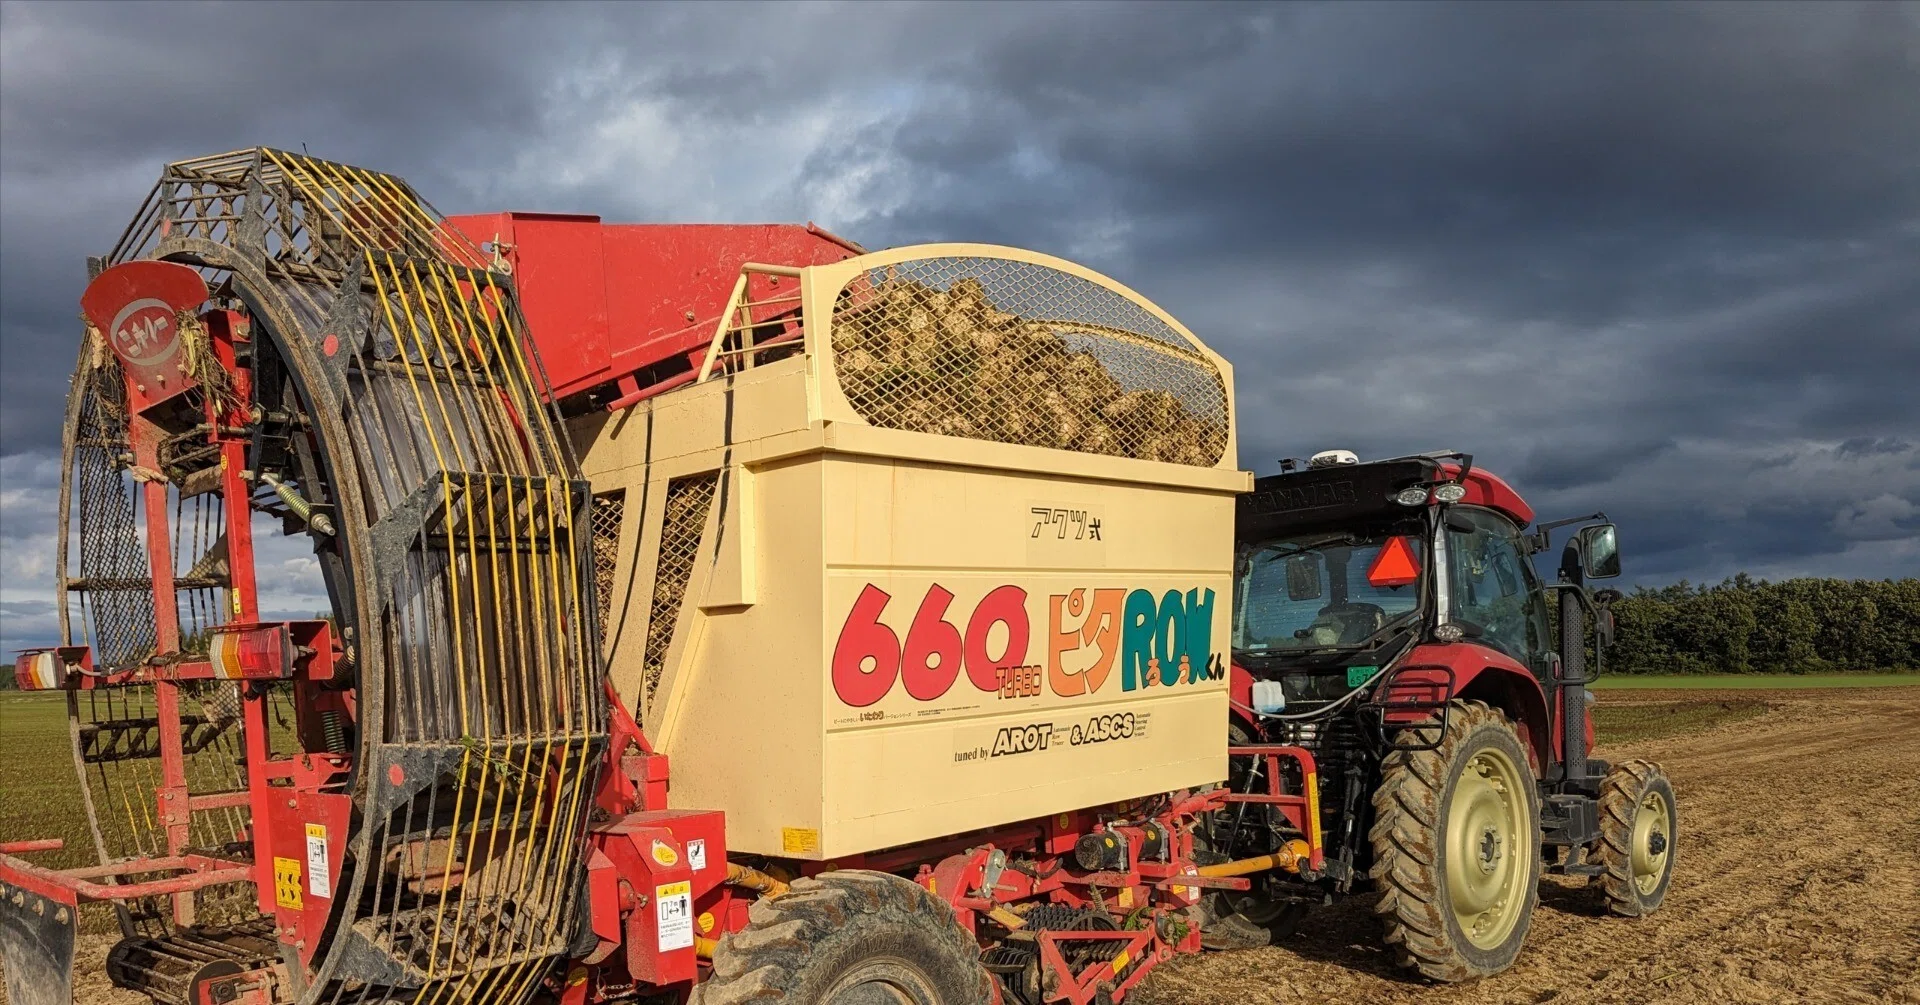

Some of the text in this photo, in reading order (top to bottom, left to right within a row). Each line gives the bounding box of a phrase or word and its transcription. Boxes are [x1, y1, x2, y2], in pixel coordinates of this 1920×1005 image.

[1030, 507, 1102, 541] アクツ式
[831, 582, 1030, 707] 660
[995, 664, 1043, 700] TURBO
[954, 712, 1135, 763] tuned by AROT & ASCS
